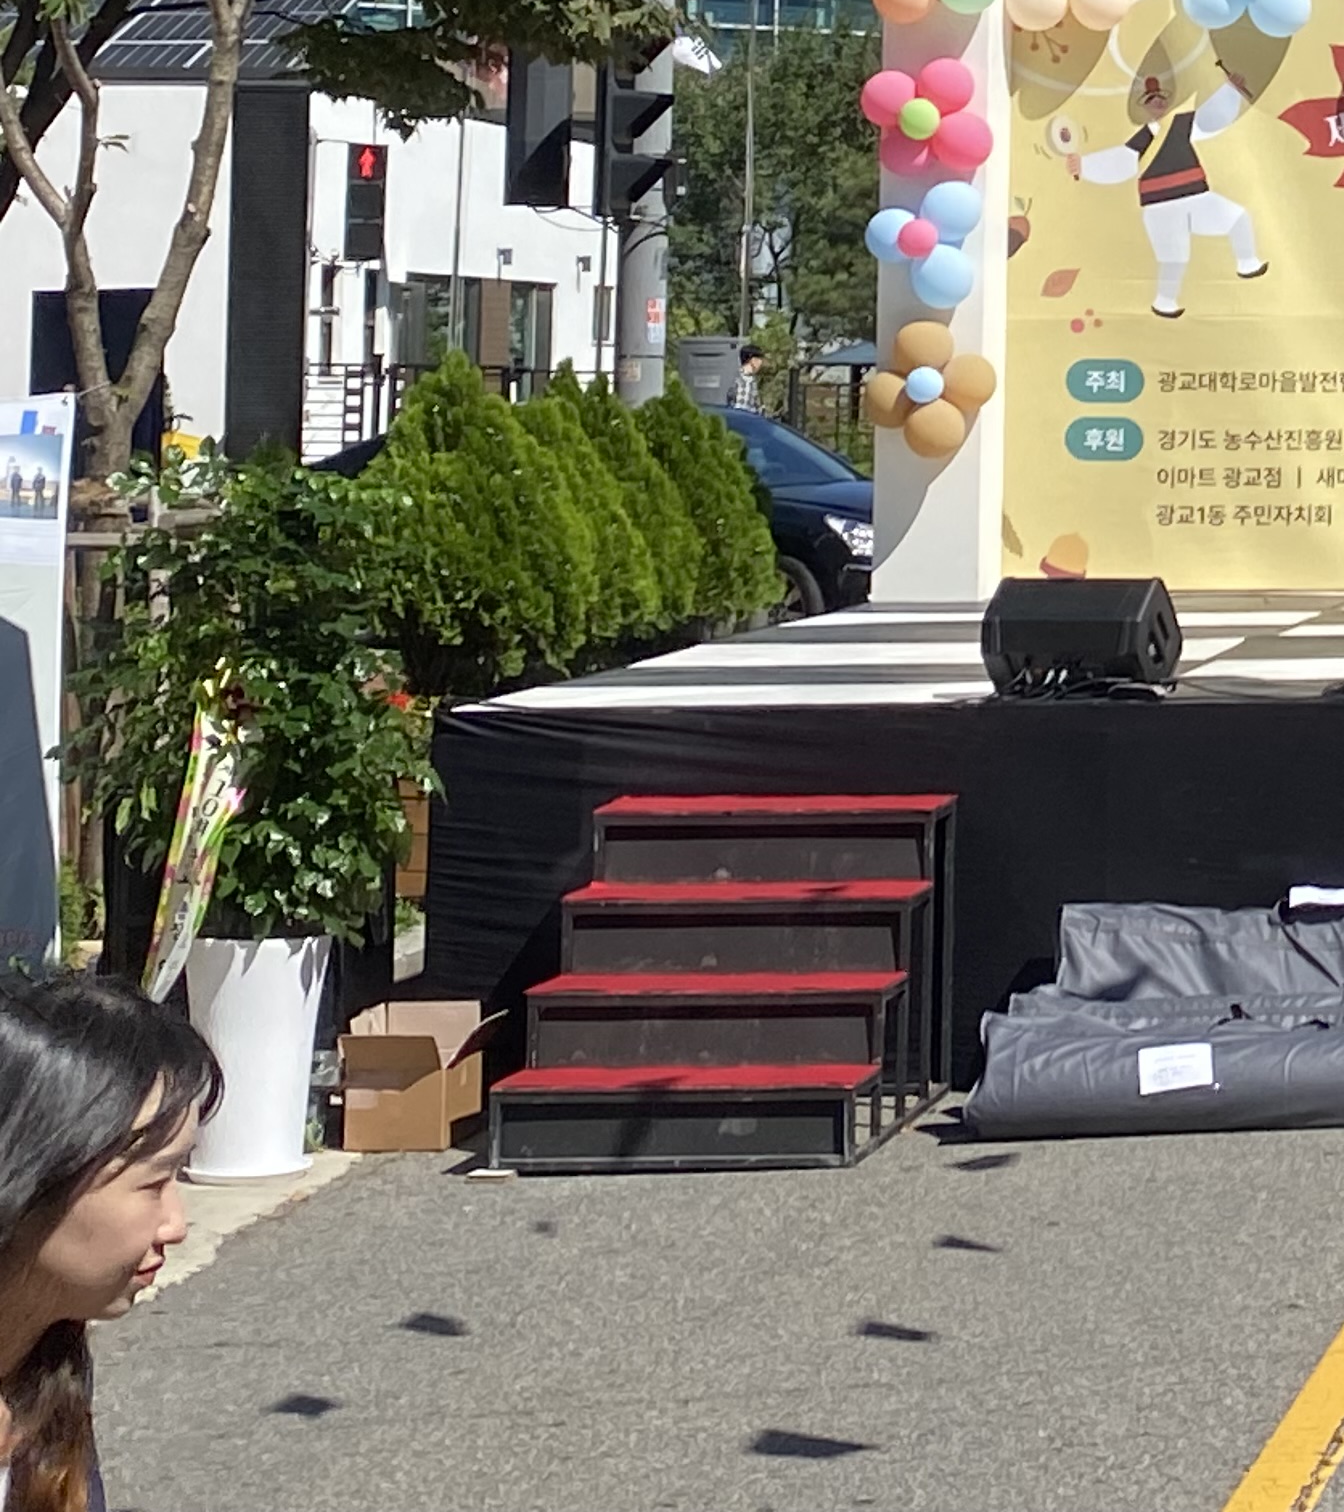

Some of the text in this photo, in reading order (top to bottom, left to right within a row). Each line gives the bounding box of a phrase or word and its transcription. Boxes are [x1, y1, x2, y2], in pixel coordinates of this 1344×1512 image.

[1085, 370, 1126, 394] 주최
[1083, 428, 1125, 453] 후원
[1157, 429, 1218, 452] 경기도
[1223, 429, 1344, 452] 농수산진흥원
[1156, 466, 1217, 489] 이마트
[1222, 466, 1283, 489] 광교점
[1155, 504, 1227, 527] 광교1동
[1231, 504, 1333, 528] 주민자치회
